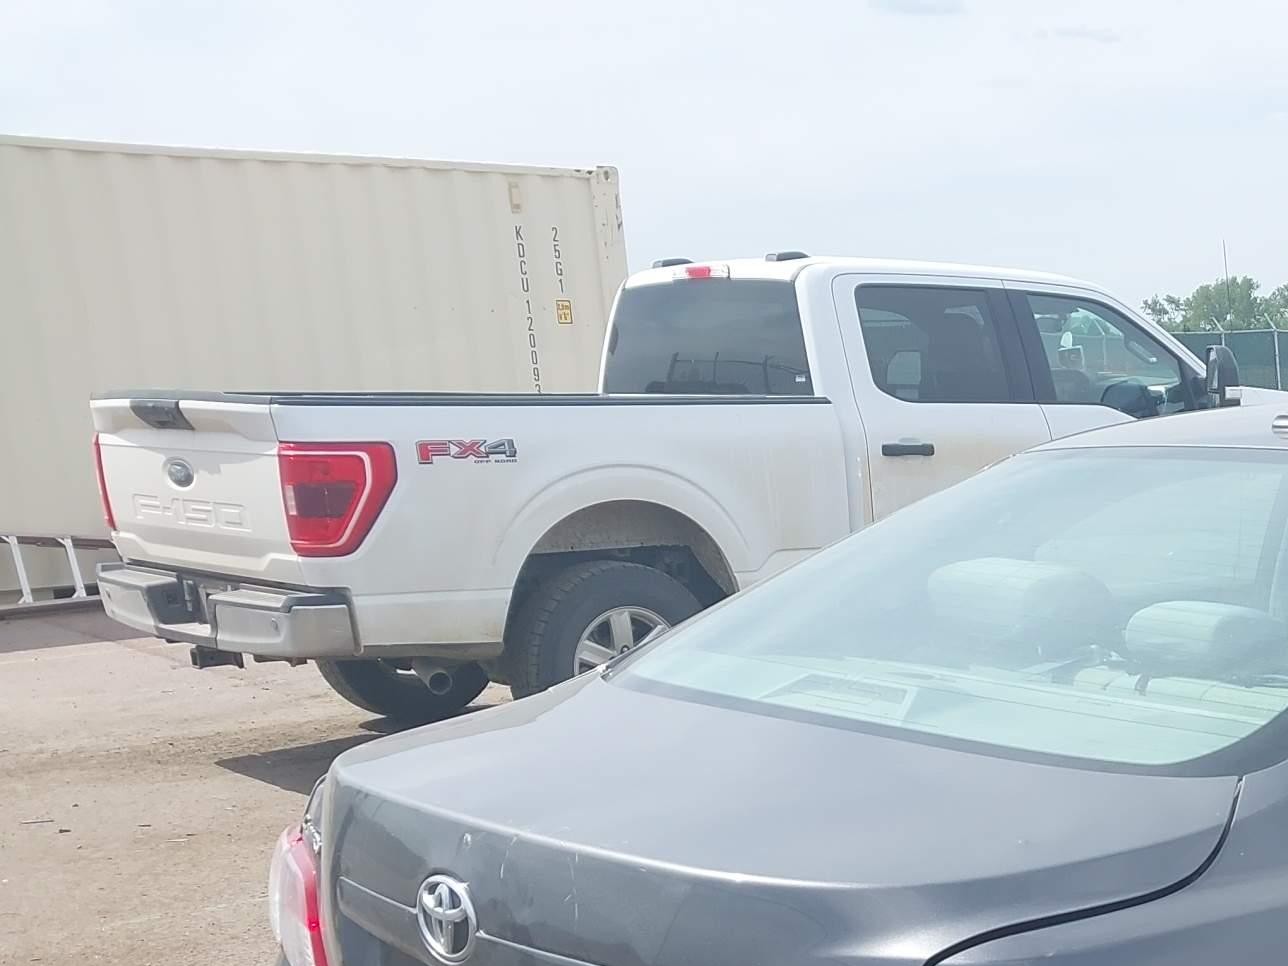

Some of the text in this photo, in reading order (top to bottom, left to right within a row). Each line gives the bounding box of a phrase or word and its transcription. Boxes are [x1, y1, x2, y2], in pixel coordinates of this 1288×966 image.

[514, 225, 530, 293] KDCU
[551, 226, 564, 293] 25G1
[415, 438, 518, 465] FX4
[131, 493, 252, 533] F-150
